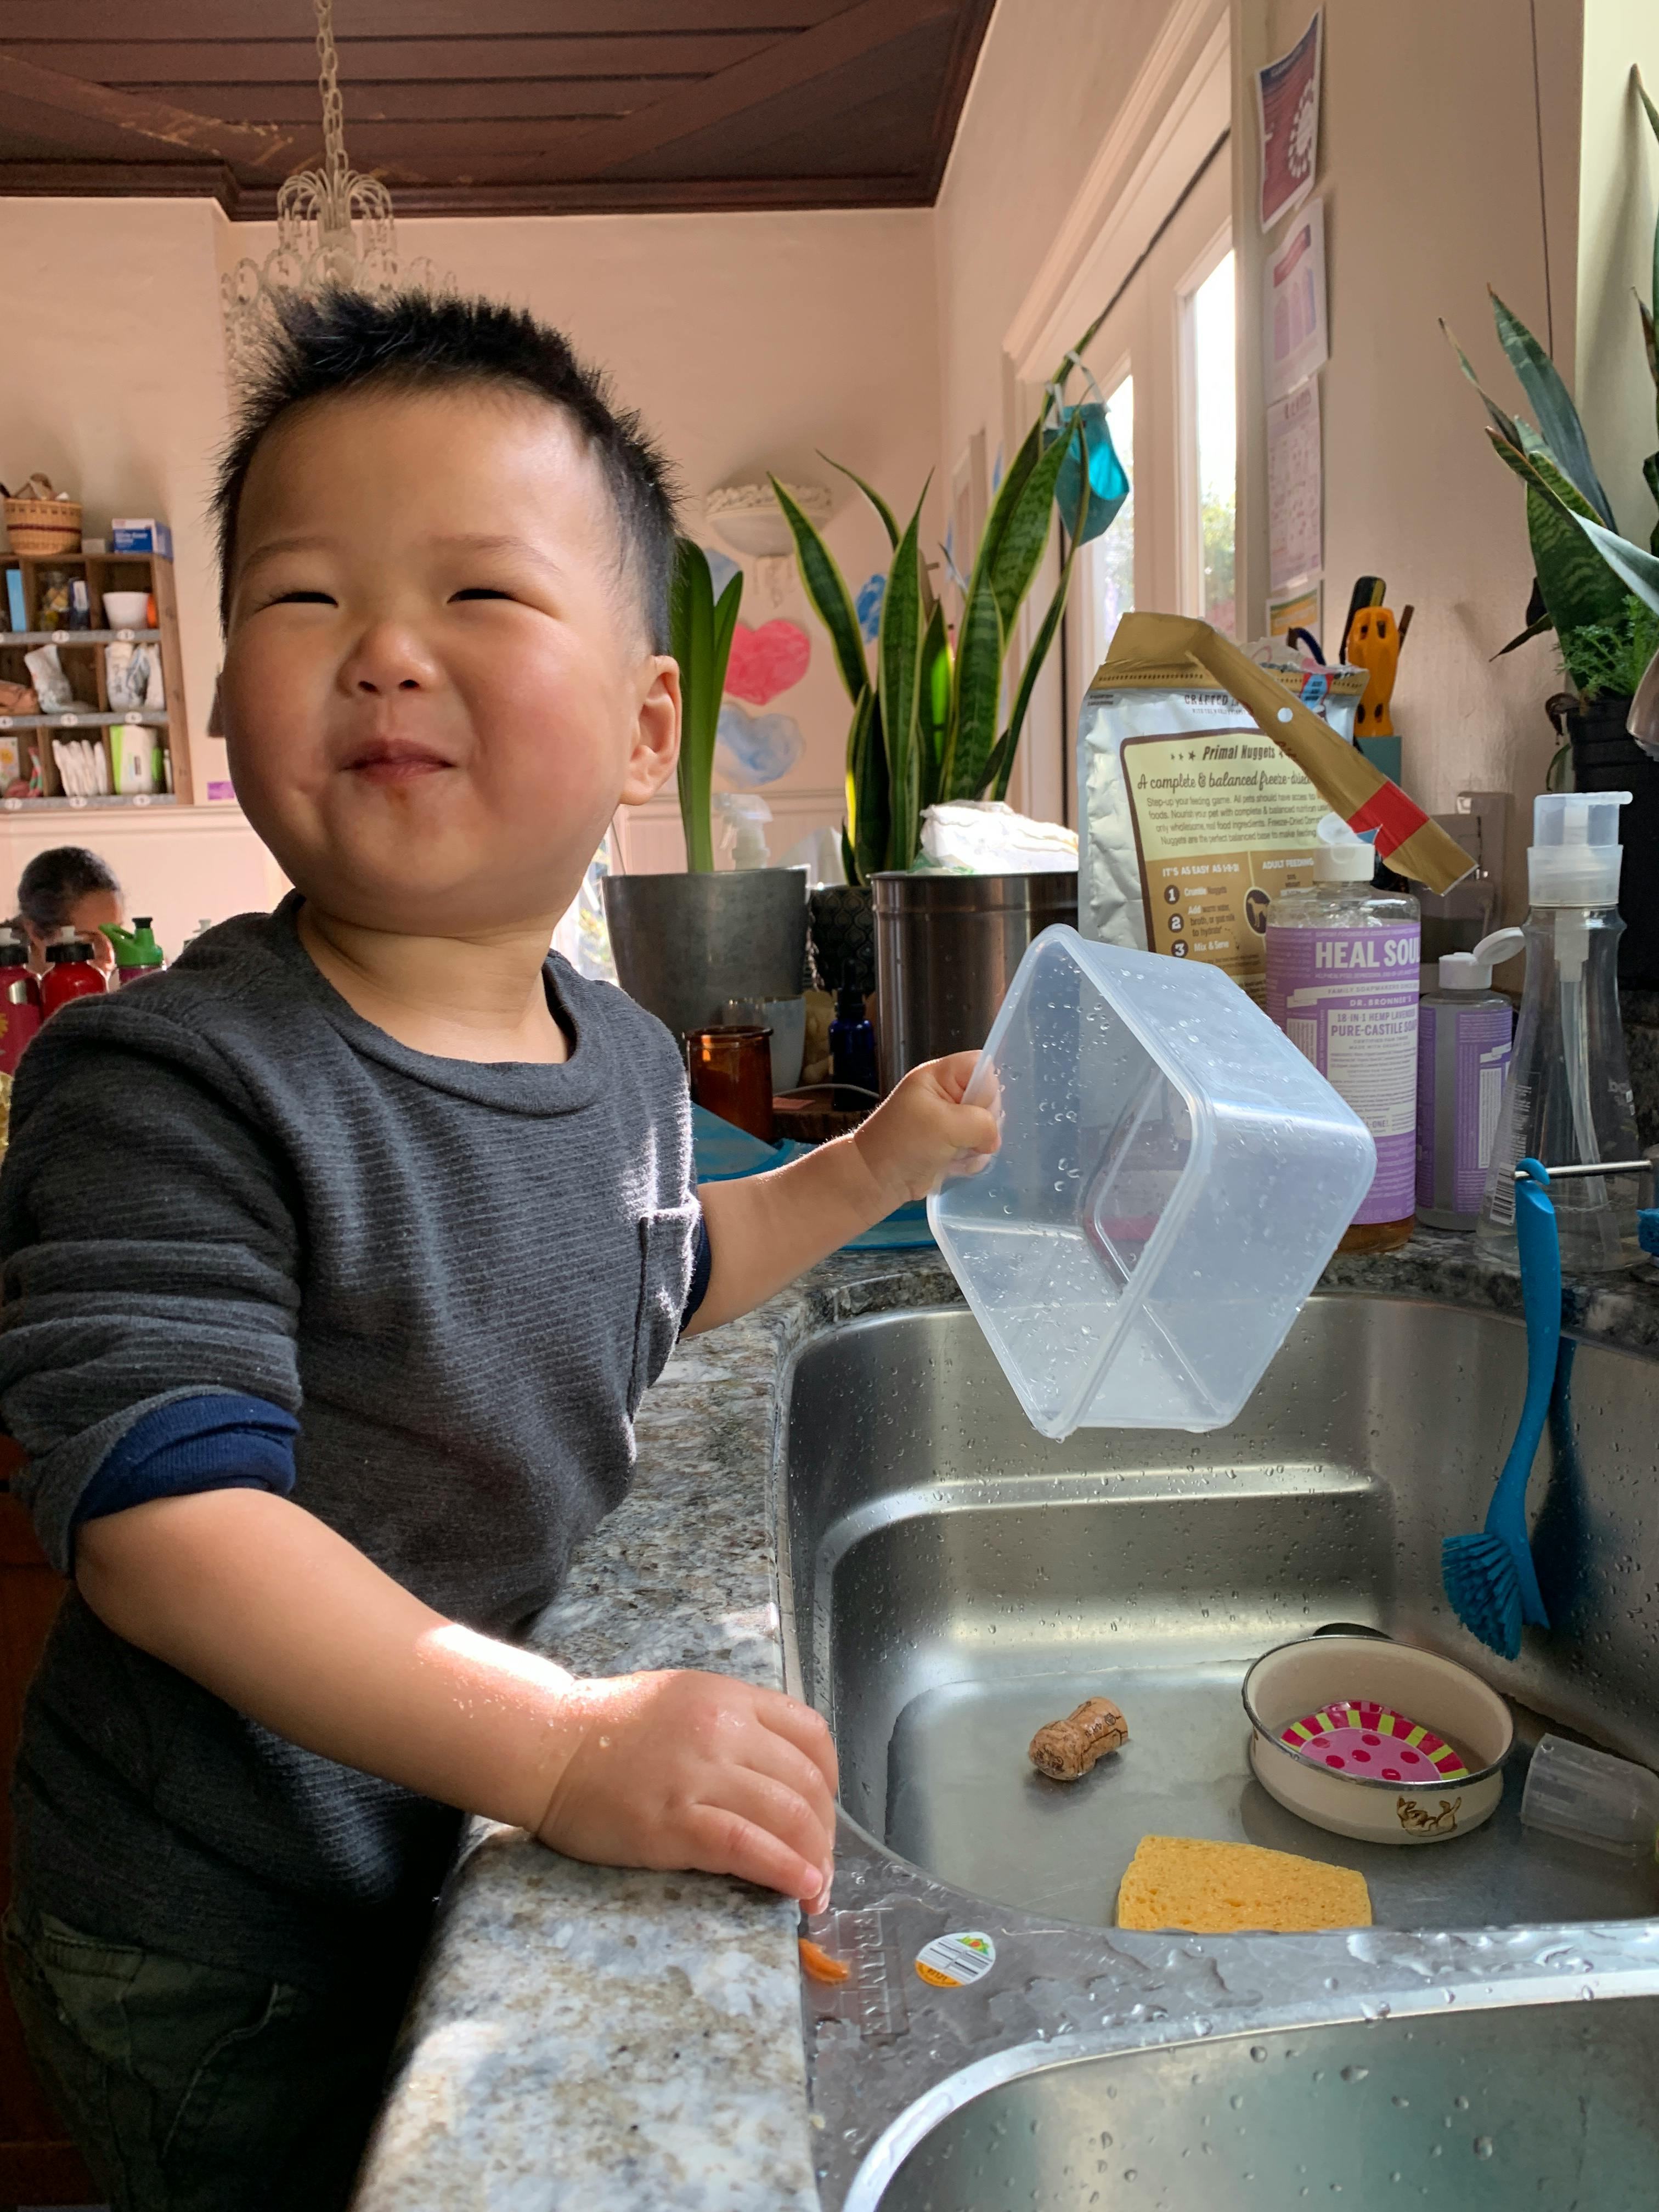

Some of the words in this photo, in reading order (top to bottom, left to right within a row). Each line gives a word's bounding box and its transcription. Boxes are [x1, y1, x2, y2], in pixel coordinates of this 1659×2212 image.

[1184, 695, 1228, 706] CRAFTED
[1203, 744, 1238, 760] Primal
[1241, 744, 1276, 760] Nuggets
[1137, 774, 1148, 789] A
[1150, 772, 1197, 794] complete
[1198, 772, 1206, 788] &
[1209, 770, 1258, 788] balanced
[1147, 797, 1173, 808] Step-up
[1220, 808, 1233, 817] with
[1217, 821, 1231, 830] food
[1262, 859, 1284, 870] ADULT
[1163, 867, 1179, 877] IT'S
[1181, 866, 1191, 876] AS
[1192, 865, 1209, 875] EASY
[1212, 864, 1221, 873] AS
[1169, 888, 1176, 901] 1
[1188, 905, 1201, 916] Add
[1171, 916, 1181, 930] 2
[1175, 943, 1185, 957] 3
[1193, 942, 1207, 952] Mix
[1316, 941, 1380, 968] HEAL
[1356, 984, 1398, 993] SOAPMAKERS
[1350, 998, 1367, 1007] DR.
[1368, 995, 1412, 1006] BRONNER'S
[1369, 1011, 1390, 1022] HEMP
[1331, 1022, 1403, 1036] PURE-CASTILE
